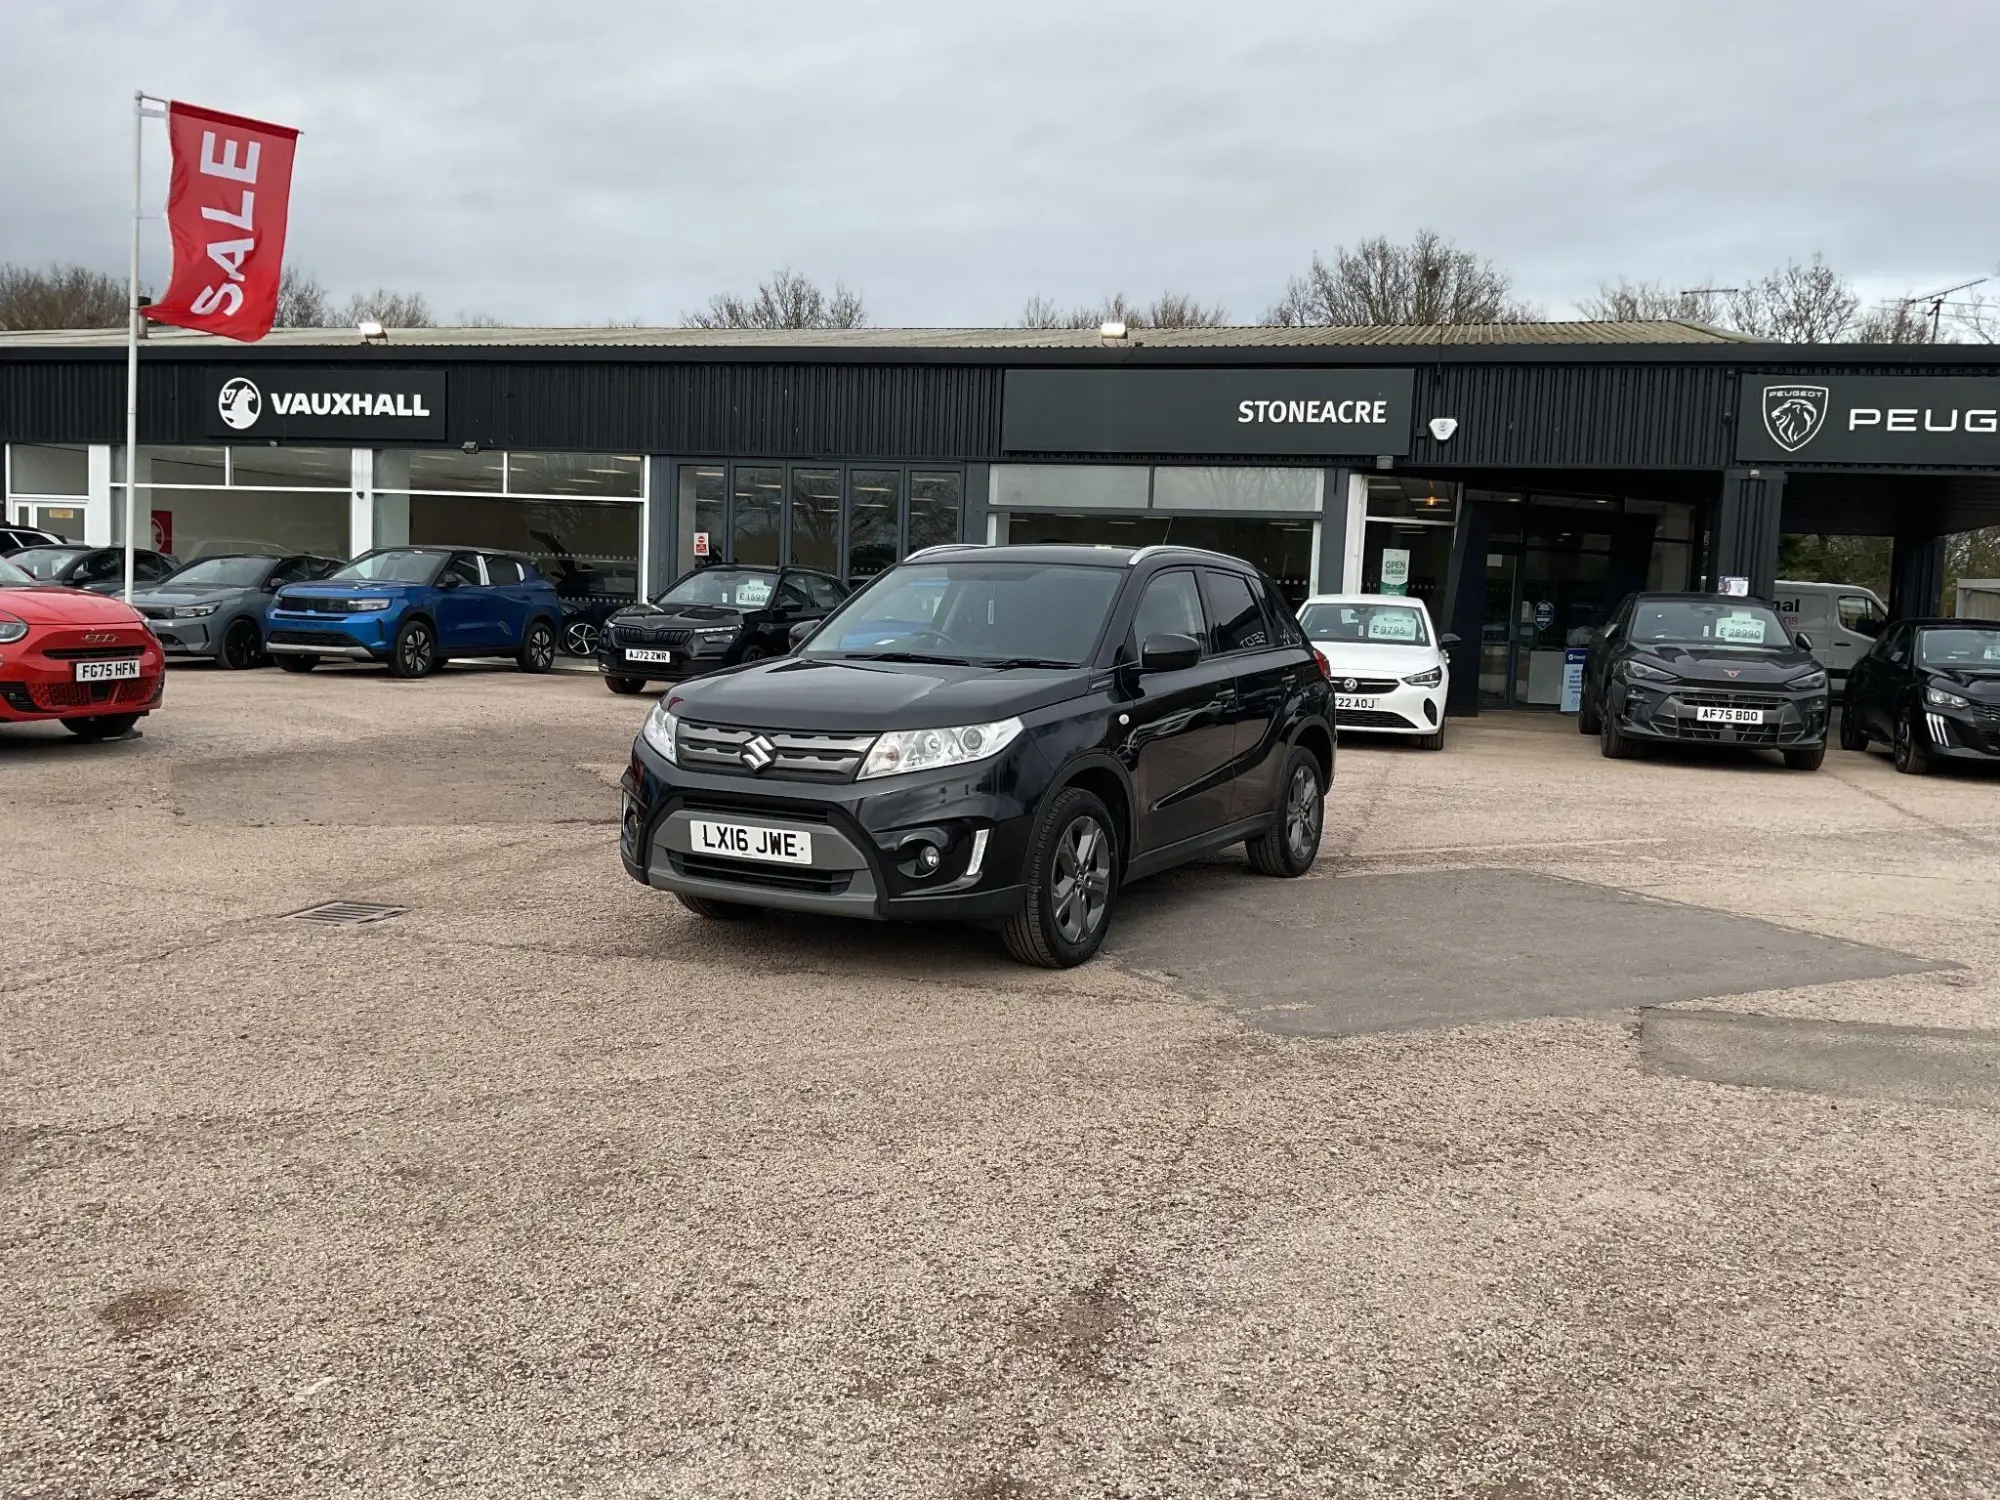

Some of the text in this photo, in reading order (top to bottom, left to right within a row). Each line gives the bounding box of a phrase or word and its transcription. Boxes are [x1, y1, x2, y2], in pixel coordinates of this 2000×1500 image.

[190, 130, 261, 317] SALE
[1768, 390, 1823, 398] PEUGEOT
[270, 392, 430, 417] VAUXHALL
[1237, 399, 1387, 424] STONEACRE
[1849, 408, 1998, 433] PEUG
[1385, 561, 1405, 569] OPEN
[629, 650, 667, 661] AJ72 ZWR
[82, 662, 136, 678] FG75 HFN
[1354, 699, 1375, 709] AOJ
[1702, 708, 1732, 720] AF75
[703, 824, 798, 857] LX16 JWE
